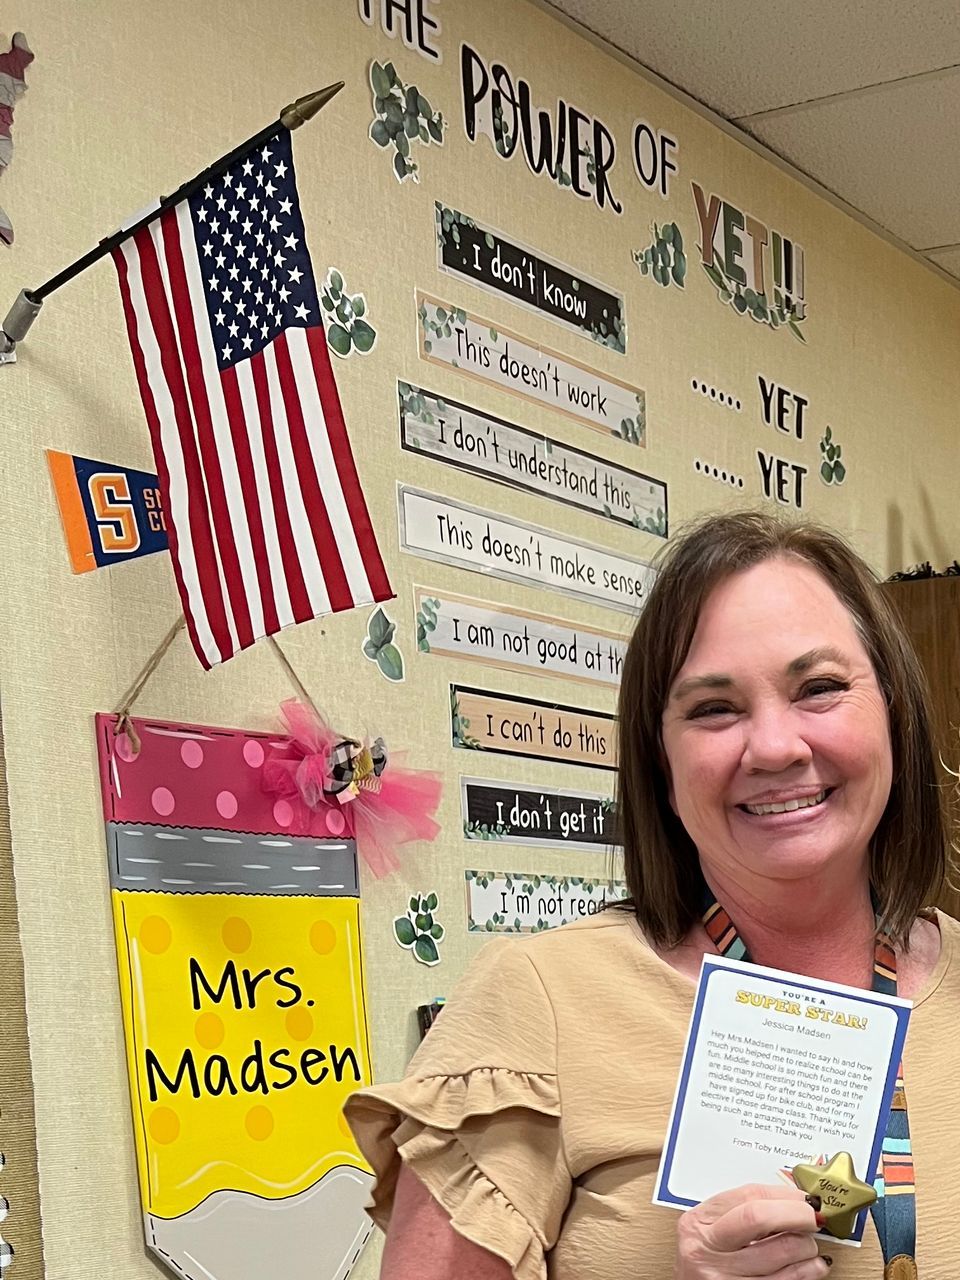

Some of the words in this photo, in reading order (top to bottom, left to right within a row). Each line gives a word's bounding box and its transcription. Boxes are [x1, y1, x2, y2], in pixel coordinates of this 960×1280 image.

[363, 0, 438, 58] HE
[462, 44, 622, 214] POWER
[634, 124, 676, 195] OF
[691, 181, 805, 320] YET!!!
[473, 244, 481, 271] I
[491, 244, 535, 294] don't
[543, 270, 586, 319] know
[455, 328, 490, 367] This
[500, 342, 560, 396] doesn't
[568, 386, 607, 416] work
[758, 375, 808, 439] YET
[438, 419, 447, 444] I
[454, 416, 499, 463] don't
[509, 444, 598, 499] understand
[603, 473, 631, 509] this
[757, 451, 807, 508] YET
[88, 473, 141, 553] S
[437, 514, 473, 550] This
[482, 523, 542, 571] doesn't
[551, 553, 595, 585] make
[603, 570, 642, 598] sense
[453, 618, 461, 642] I
[468, 624, 494, 648] am
[503, 625, 529, 655] not
[538, 633, 577, 664] good
[585, 641, 602, 671] at
[486, 714, 494, 737] I
[501, 712, 544, 744] can't
[553, 717, 572, 748] do
[578, 722, 606, 755] this
[496, 801, 505, 825] I
[510, 794, 552, 830] don't
[560, 803, 586, 837] get
[593, 805, 604, 835] it
[500, 886, 530, 914] I'm
[538, 884, 563, 916] not
[190, 957, 315, 1010] Mrs.
[783, 990, 815, 1003] YOU'RE
[735, 991, 802, 1016] SUPER
[804, 1005, 868, 1031] STAR!
[761, 1018, 795, 1032] Jessica
[796, 1025, 831, 1040] Madsen
[145, 1039, 361, 1102] Madsen
[706, 1040, 729, 1051] much
[729, 1045, 745, 1054] you
[745, 1047, 772, 1060] helped
[771, 1054, 785, 1063] me
[785, 1057, 795, 1065] to
[794, 1060, 820, 1071] realize
[820, 1066, 847, 1077] school
[847, 1071, 862, 1080] can
[862, 1073, 873, 1082] be
[711, 1030, 726, 1041] Hey
[743, 1037, 774, 1050] Madsen
[780, 1047, 808, 1058] wanted
[808, 1052, 817, 1060] to
[818, 1054, 832, 1064] say
[832, 1056, 840, 1064] hi
[841, 1060, 856, 1068] and
[856, 1062, 872, 1071] how
[708, 1061, 721, 1070] are
[722, 1064, 733, 1072] so
[733, 1067, 755, 1078] many
[755, 1071, 796, 1088] interesting
[796, 1080, 820, 1092] things
[821, 1085, 830, 1094] to
[830, 1087, 841, 1096] do
[841, 1090, 850, 1098] at
[851, 1091, 864, 1101] the
[708, 1071, 734, 1083] middle
[764, 1082, 778, 1092] For
[778, 1086, 797, 1096] after
[797, 1091, 823, 1102] school
[823, 1097, 856, 1109] program
[723, 1053, 750, 1066] Middle
[751, 1060, 777, 1072] school
[777, 1065, 785, 1074] is
[786, 1068, 796, 1076] so
[796, 1070, 819, 1081] much
[819, 1073, 833, 1084] fun
[833, 1076, 848, 1087] and
[849, 1081, 869, 1092] there
[700, 1090, 730, 1103] elective
[759, 1102, 785, 1114] drama
[809, 1112, 832, 1125] Thank
[832, 1119, 848, 1128] you
[848, 1121, 860, 1130] for
[700, 1099, 722, 1113] being
[722, 1105, 742, 1115] such
[742, 1110, 753, 1118] an
[754, 1112, 787, 1127] amazing
[823, 1127, 841, 1137] wish
[841, 1131, 856, 1140] you
[708, 1080, 728, 1092] have
[728, 1086, 755, 1098] signed
[755, 1092, 766, 1101] up
[766, 1093, 778, 1102] for
[778, 1096, 796, 1107] bike
[815, 1105, 830, 1114] and
[830, 1107, 843, 1116] for
[842, 1111, 856, 1121] my
[732, 1137, 753, 1148] From
[754, 1141, 773, 1154] Toby
[740, 1119, 753, 1128] the
[775, 1125, 798, 1137] Thank
[798, 1132, 813, 1141] you
[818, 1178, 849, 1195] You're
[822, 1195, 846, 1208] Star
